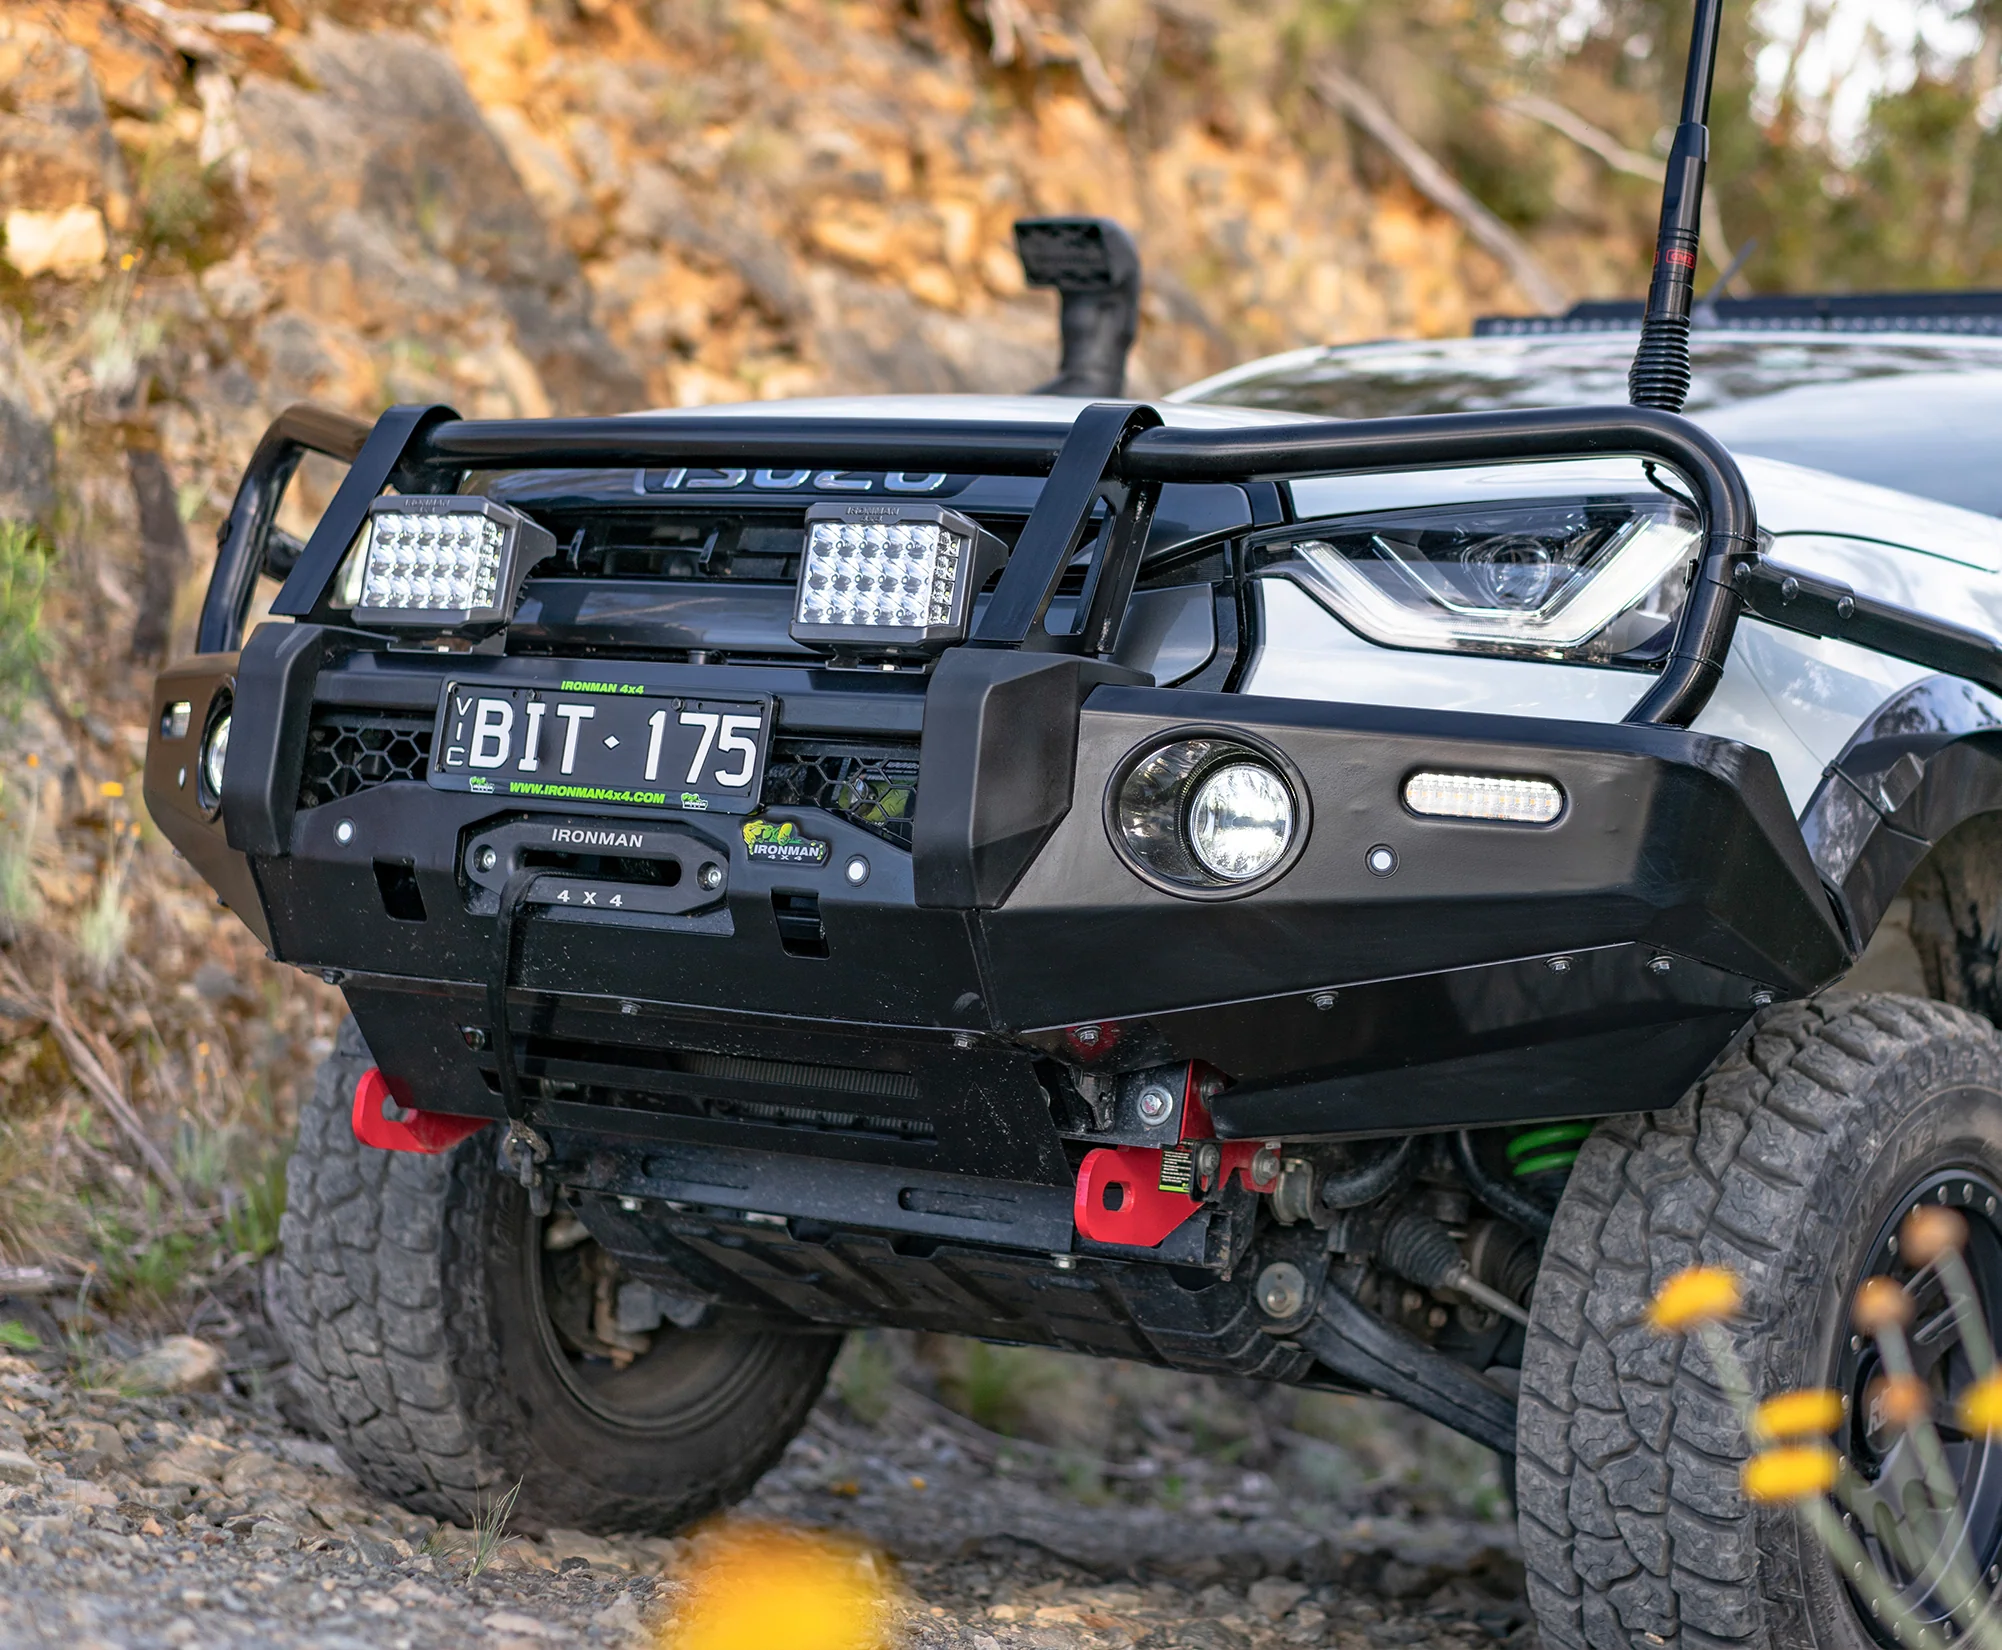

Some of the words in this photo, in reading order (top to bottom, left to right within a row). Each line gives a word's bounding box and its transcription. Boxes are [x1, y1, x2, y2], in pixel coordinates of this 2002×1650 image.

[846, 507, 900, 515] IRONMAN
[561, 681, 617, 693] IRONMAN
[619, 684, 645, 694] 4x4
[446, 697, 473, 766] VIC
[468, 698, 595, 775] BIT
[643, 709, 762, 788] 175
[509, 782, 666, 804] WWW.IRONMAN4x4.COM
[552, 828, 643, 848] IRONMAN
[753, 844, 820, 857] IRONMAN
